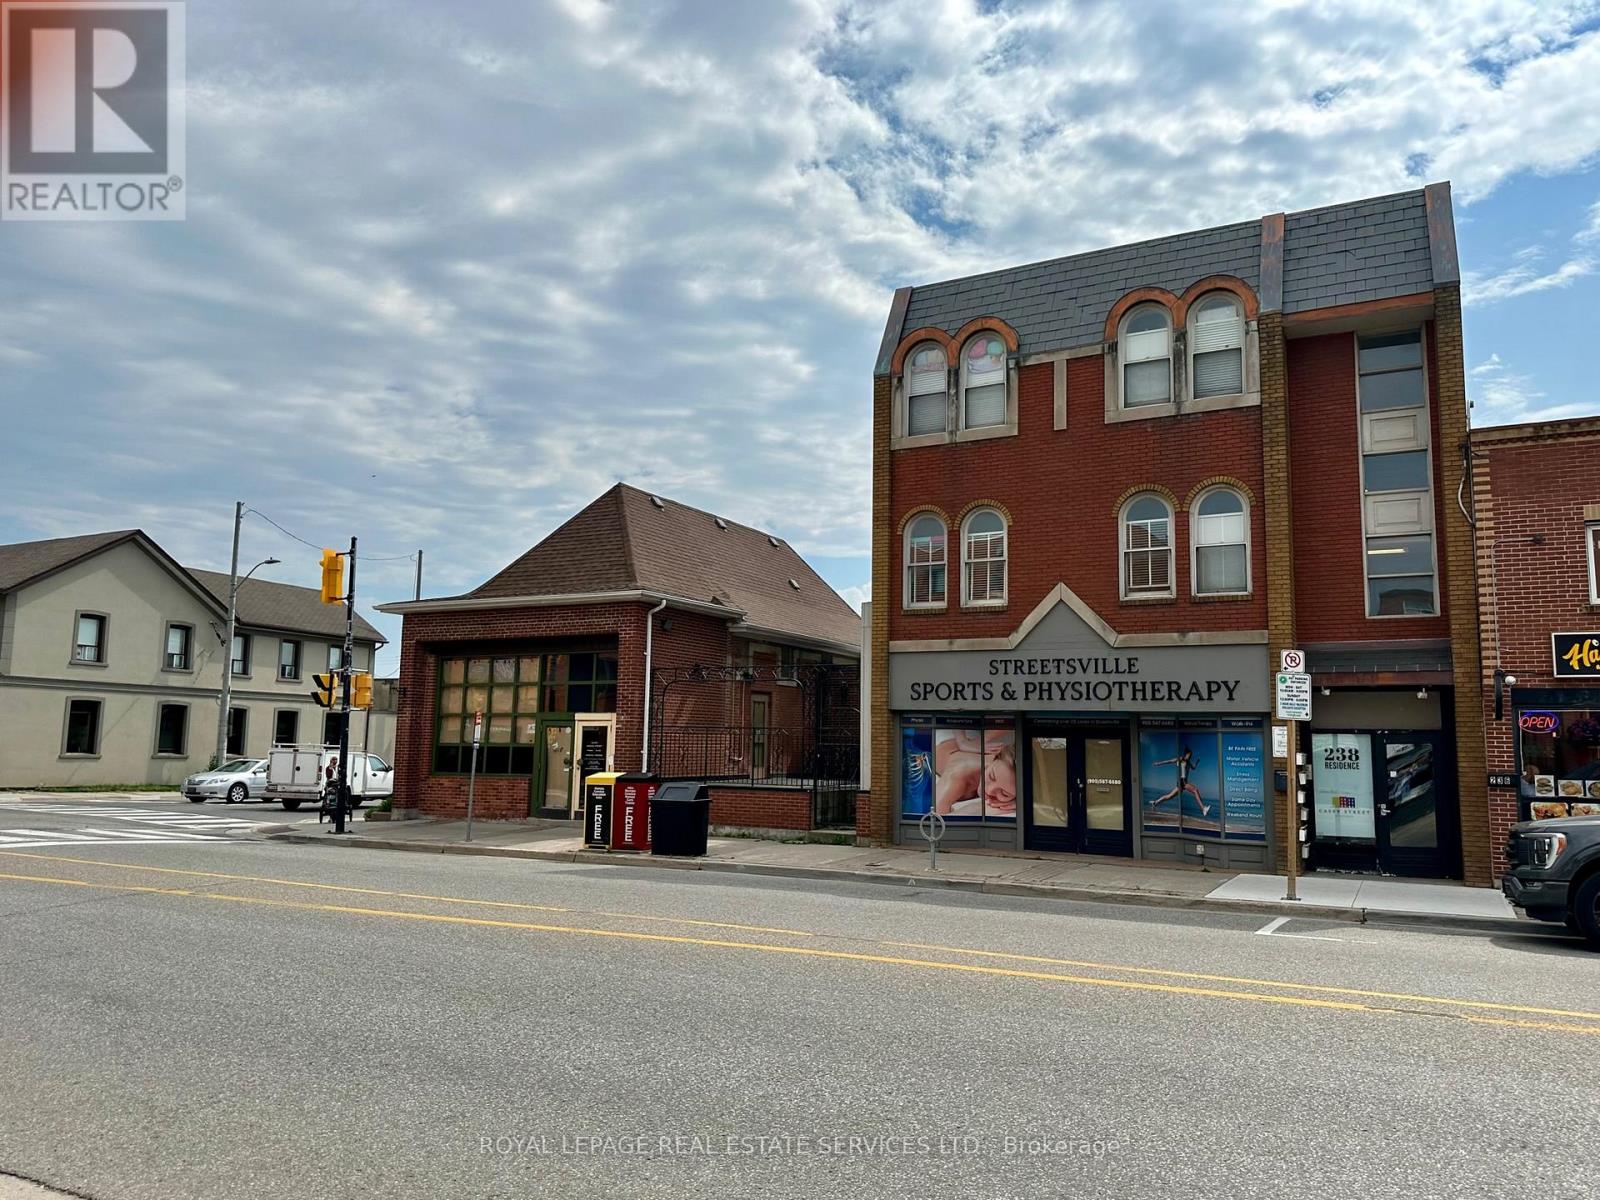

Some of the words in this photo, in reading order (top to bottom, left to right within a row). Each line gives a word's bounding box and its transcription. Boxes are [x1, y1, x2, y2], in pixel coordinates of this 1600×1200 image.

[989, 657, 1140, 675] STREETSVILLE
[910, 682, 994, 701] SPORTS
[1000, 682, 1018, 701] &
[1023, 680, 1241, 701] PHYSIOTHERAPY
[1521, 716, 1555, 728] OPEN
[1324, 747, 1360, 762] 238
[1325, 762, 1360, 770] RESIDENCE
[594, 804, 603, 840] FREE
[624, 806, 634, 842] FREE
